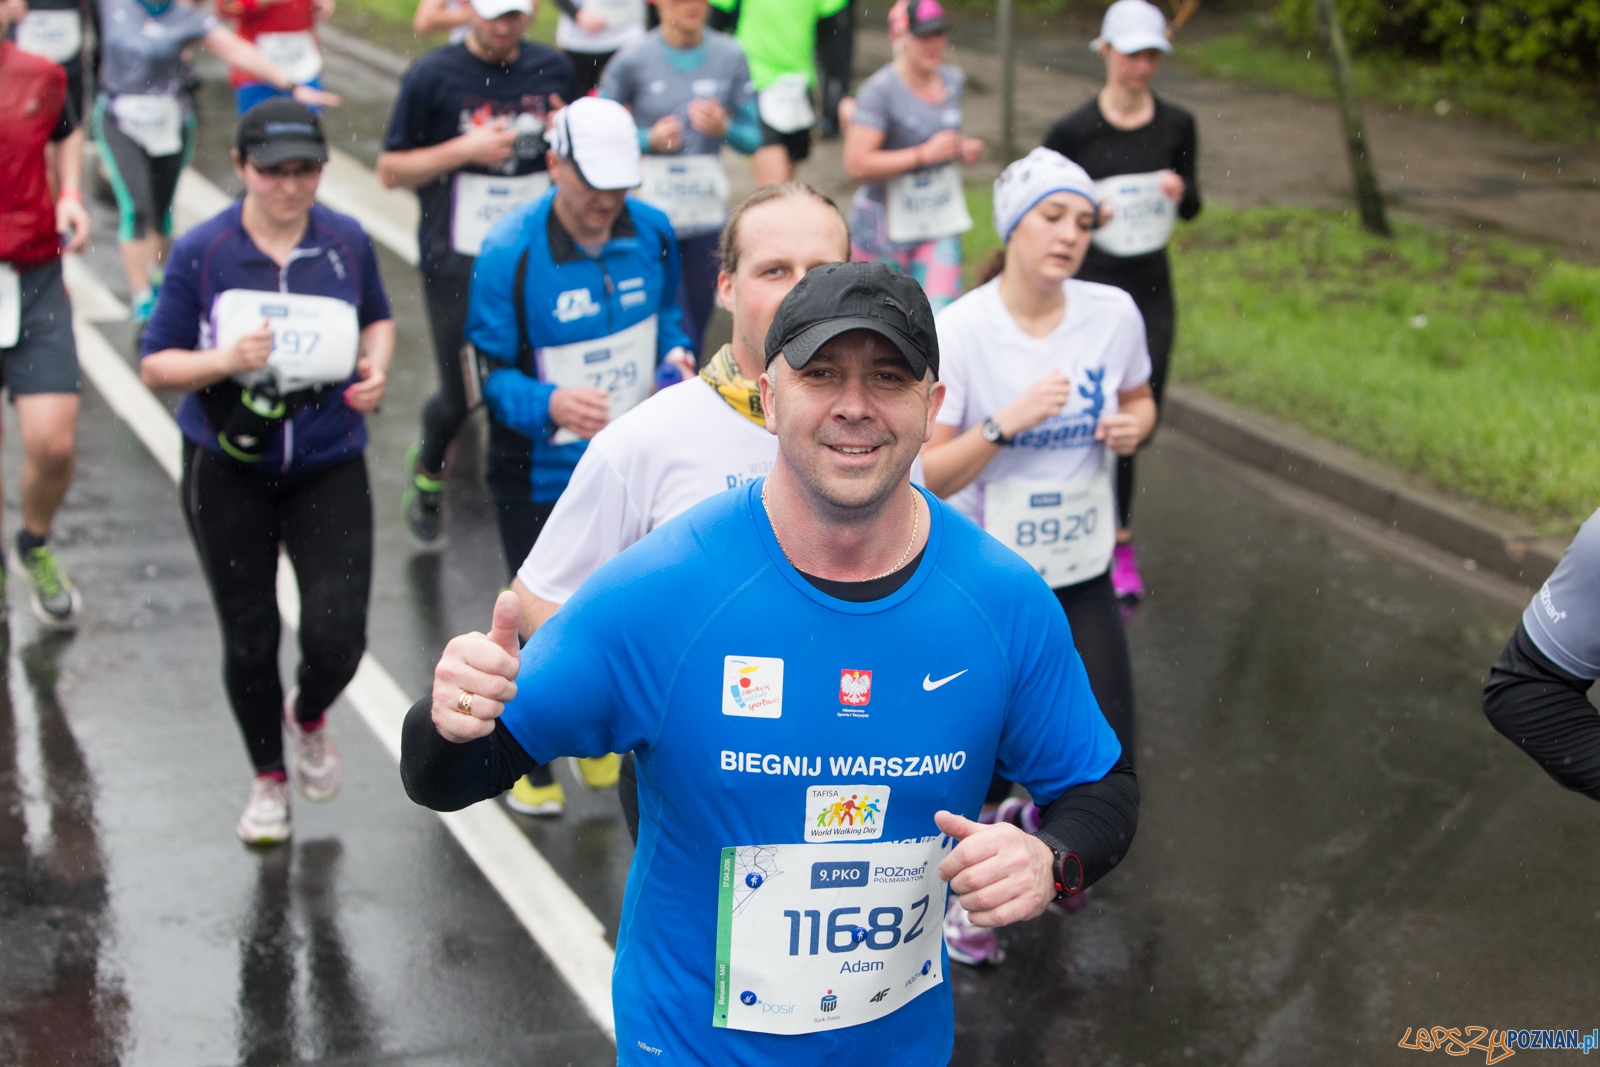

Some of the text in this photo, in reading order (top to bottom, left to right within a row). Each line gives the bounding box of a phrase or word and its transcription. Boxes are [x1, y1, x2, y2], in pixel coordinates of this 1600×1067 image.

[1016, 507, 1098, 547] 8920
[721, 750, 967, 777] BIEGNIJ WARSZAWO
[812, 789, 839, 798] TAFISA
[811, 826, 878, 837] World Walking Day
[723, 858, 731, 888] 17.04.2016
[832, 868, 861, 881] PKO
[873, 874, 924, 883] PÓŁMARATON
[783, 894, 930, 956] 11682
[839, 960, 884, 974] Adam
